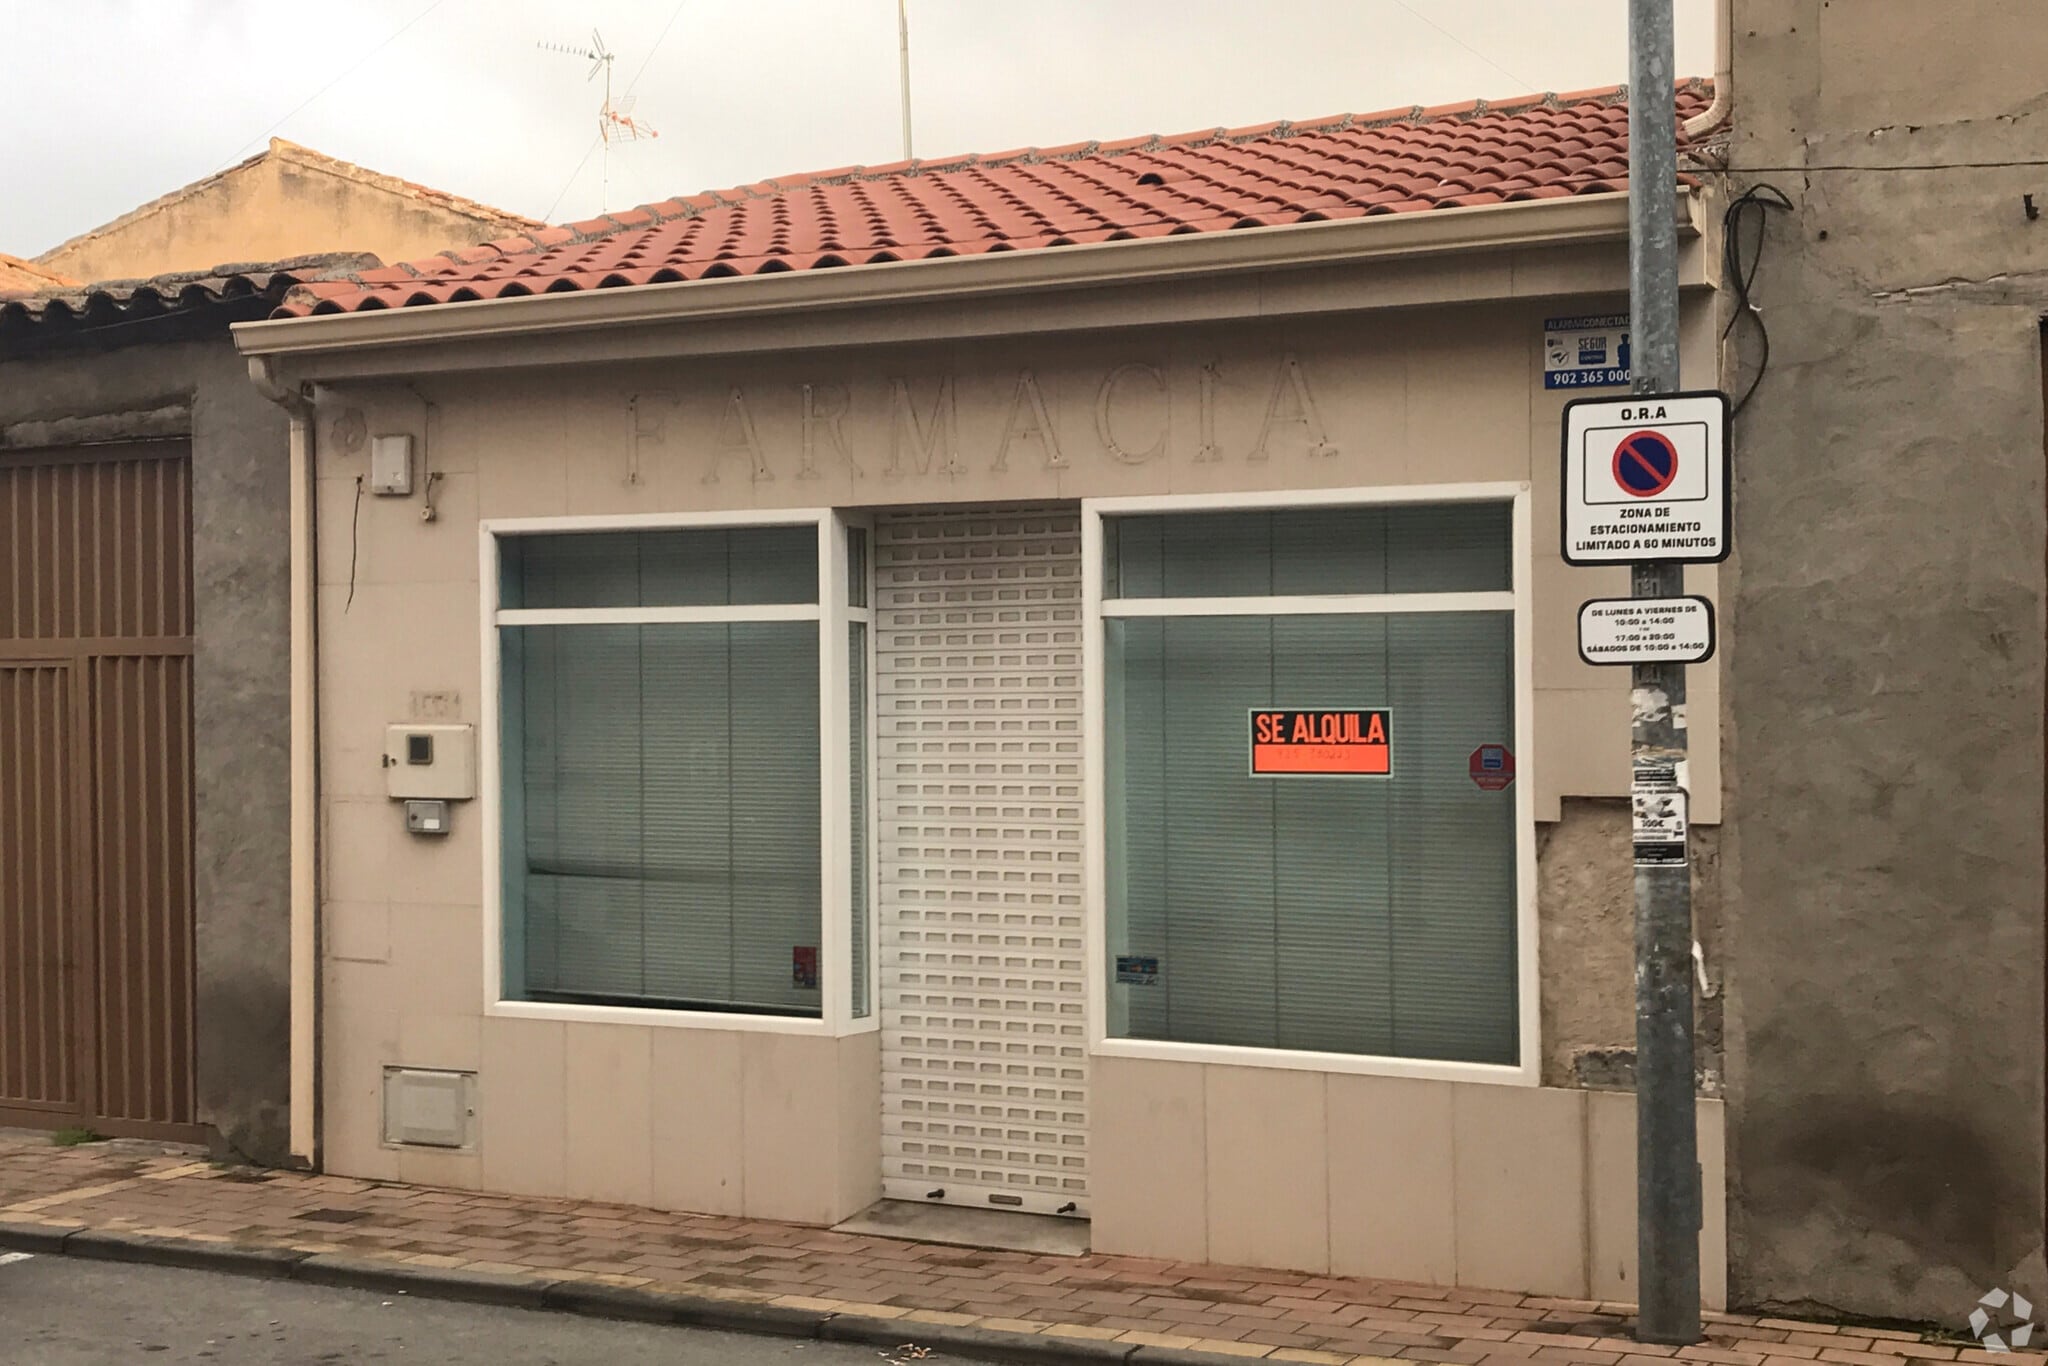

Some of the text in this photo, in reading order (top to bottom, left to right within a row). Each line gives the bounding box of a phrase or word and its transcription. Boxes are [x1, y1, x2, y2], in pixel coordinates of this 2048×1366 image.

[1578, 336, 1606, 350] SEGUR
[1553, 369, 1630, 385] 902 365 000
[621, 354, 1340, 486] FARMACIA
[1621, 406, 1667, 421] O.R.A
[1620, 507, 1670, 519] ZONA DE
[1590, 522, 1700, 535] ESTACIONAMIENTO
[1576, 537, 1716, 551] LIMITADO A 60 MINUTOS
[1592, 605, 1697, 617] DE LUNES A VIERNES DE
[1649, 617, 1675, 625] 14:00
[1629, 644, 1641, 652] DE
[1679, 642, 1705, 650] 14:00
[1256, 711, 1386, 745] SE ALQUILA
